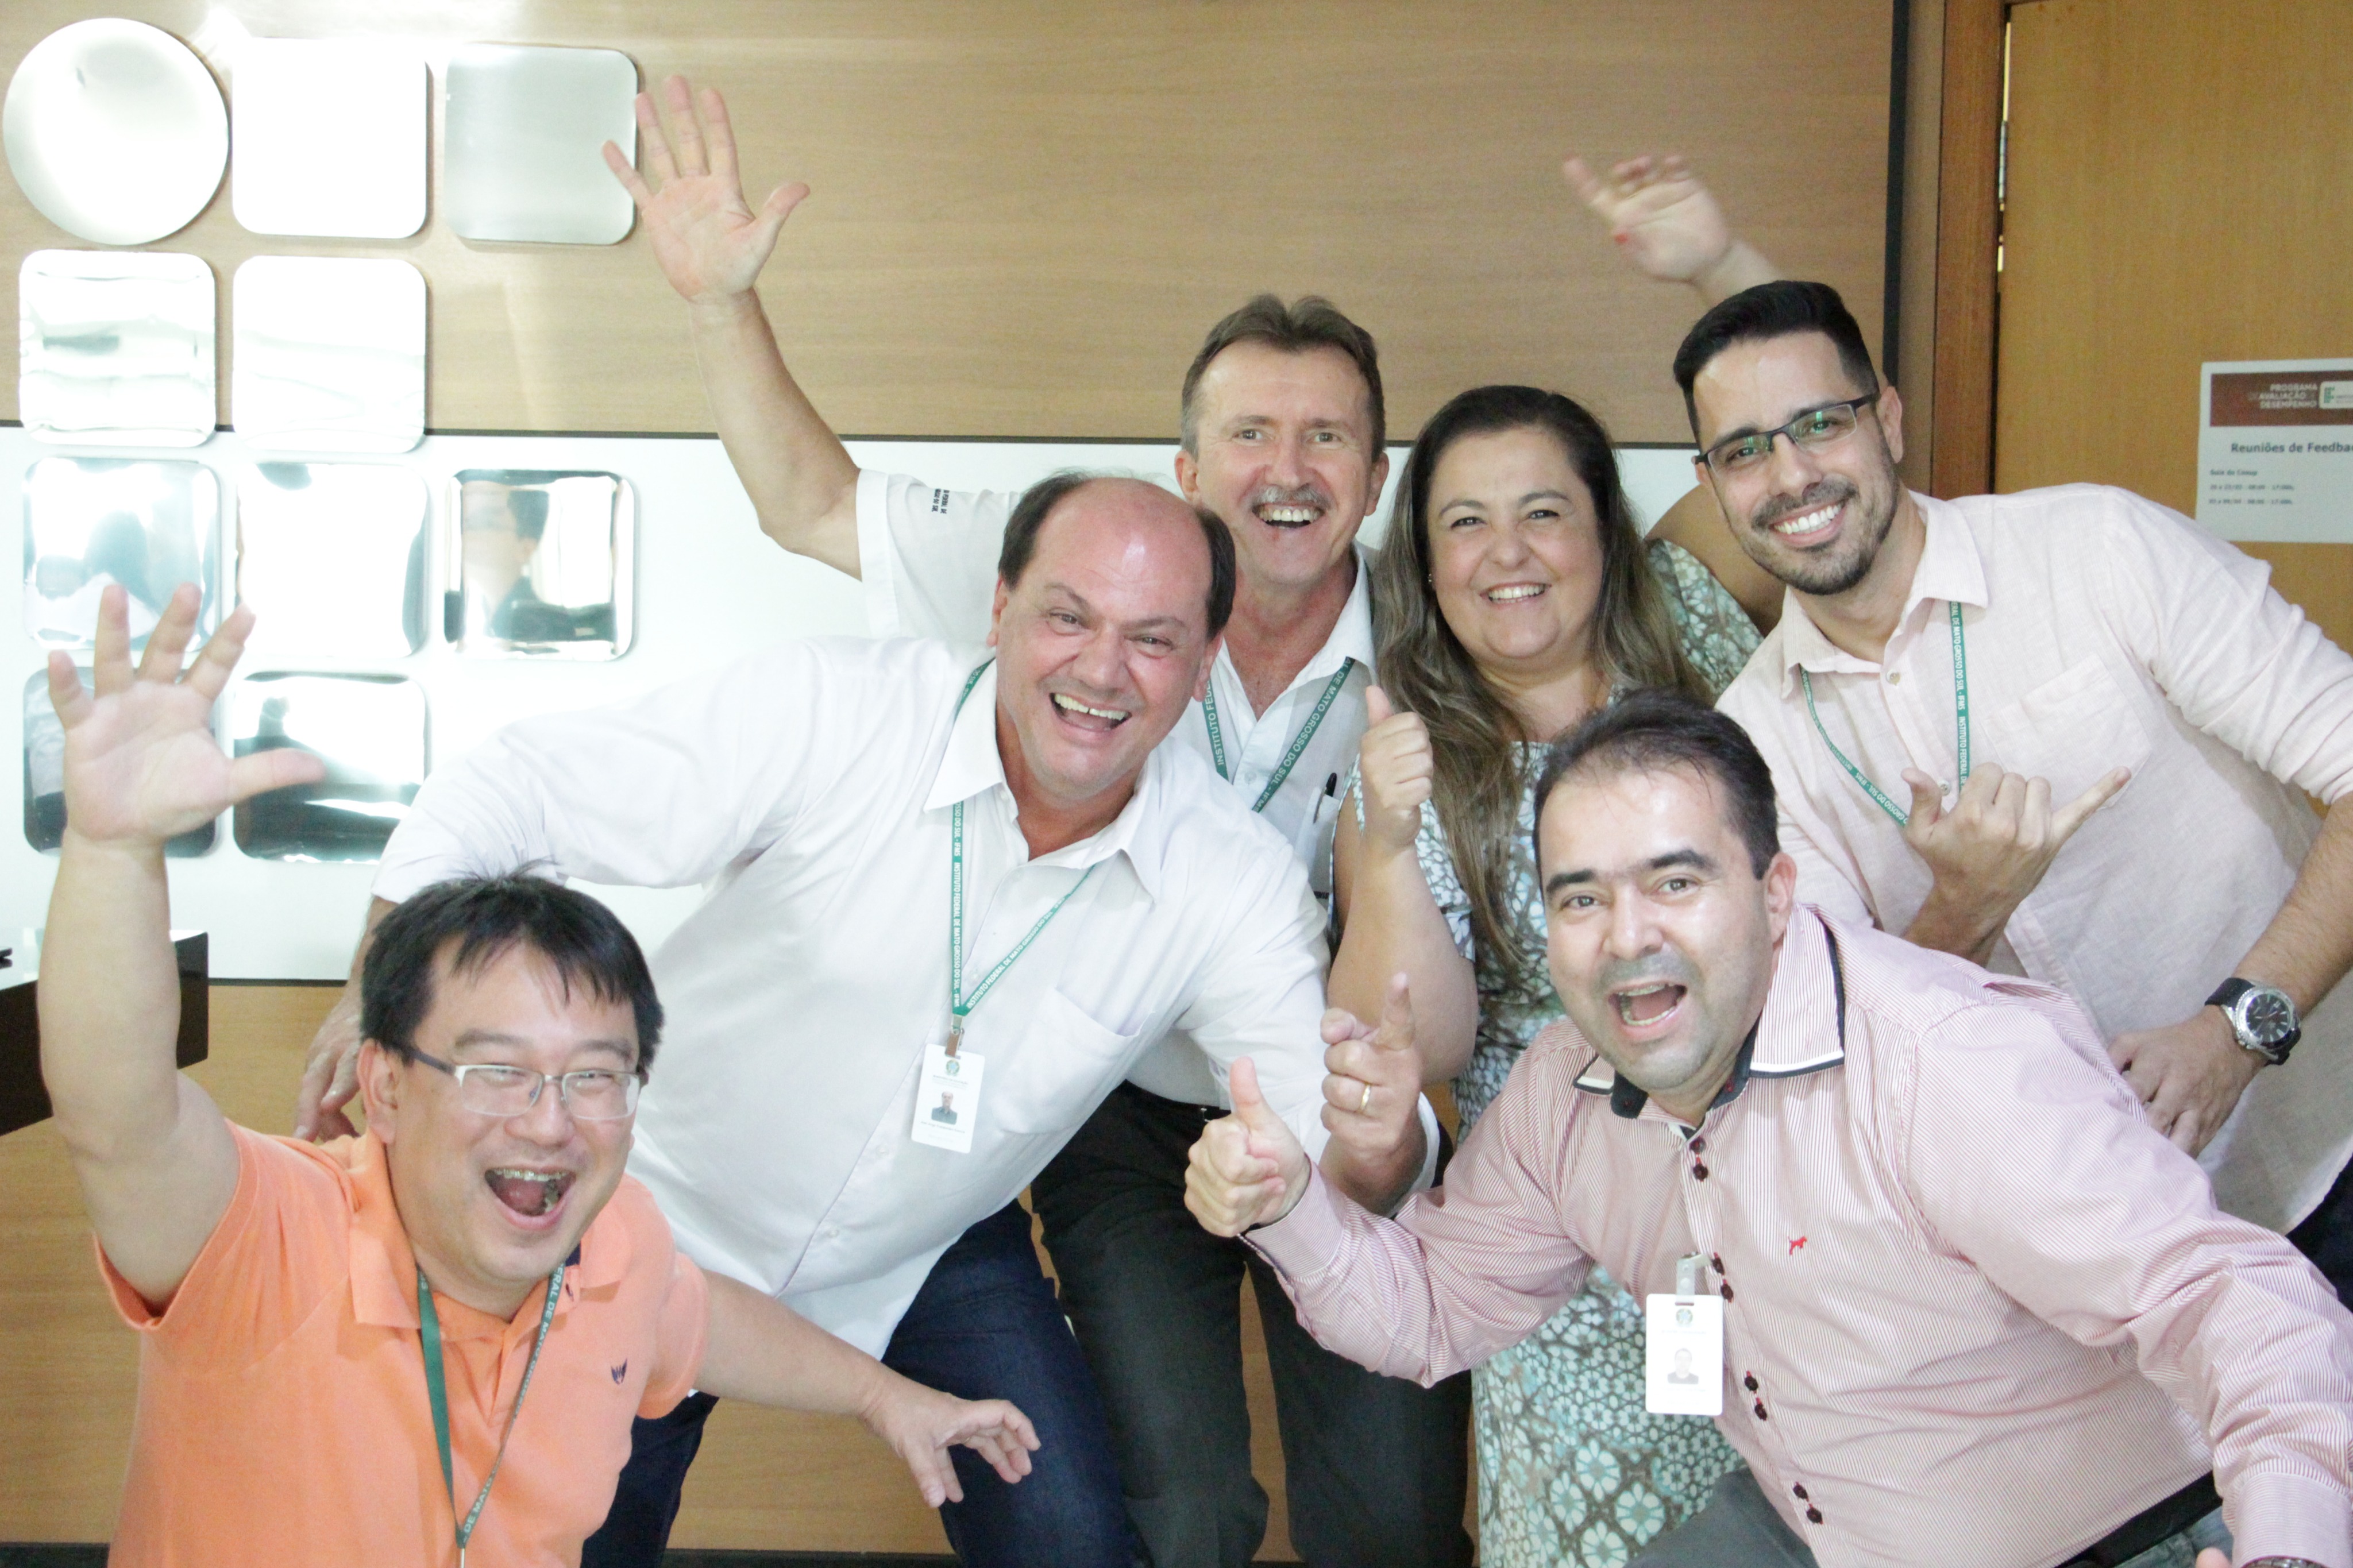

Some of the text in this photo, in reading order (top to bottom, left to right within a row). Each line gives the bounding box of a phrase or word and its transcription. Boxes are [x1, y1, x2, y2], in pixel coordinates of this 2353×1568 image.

[2231, 442, 2285, 453] Reuniões
[2289, 442, 2303, 453] de
[1953, 627, 1961, 644] MATO
[1954, 645, 1963, 669] GROSSO
[1333, 671, 1345, 685] DE
[1956, 670, 1964, 679] DO
[1318, 685, 1336, 712] MATO
[1208, 713, 1225, 765] INSTITUTO
[1293, 713, 1320, 752] GROSSO
[1958, 716, 1966, 747] INSTITUTO
[1283, 752, 1296, 767] DO
[1271, 767, 1286, 785] SUL
[1856, 772, 1867, 786] IFMS
[1869, 785, 1878, 797] SUL
[1876, 793, 1887, 804] DO
[1884, 800, 1905, 820] GROSSO
[954, 817, 962, 827] DO
[953, 862, 961, 893] INSTITUTO
[953, 918, 961, 926] DE
[966, 983, 988, 1009] INSTITUTO
[985, 964, 1006, 986] FEDERAL
[1003, 957, 1012, 966] DE
[1009, 945, 1023, 960] MATO
[1022, 926, 1039, 946] GROSSO
[1037, 919, 1046, 928] DO
[954, 969, 961, 978] DO
[550, 1265, 564, 1297] ERAL
[545, 1301, 555, 1319] DE
[535, 1321, 549, 1356] MATO
[464, 1515, 476, 1533] DE
